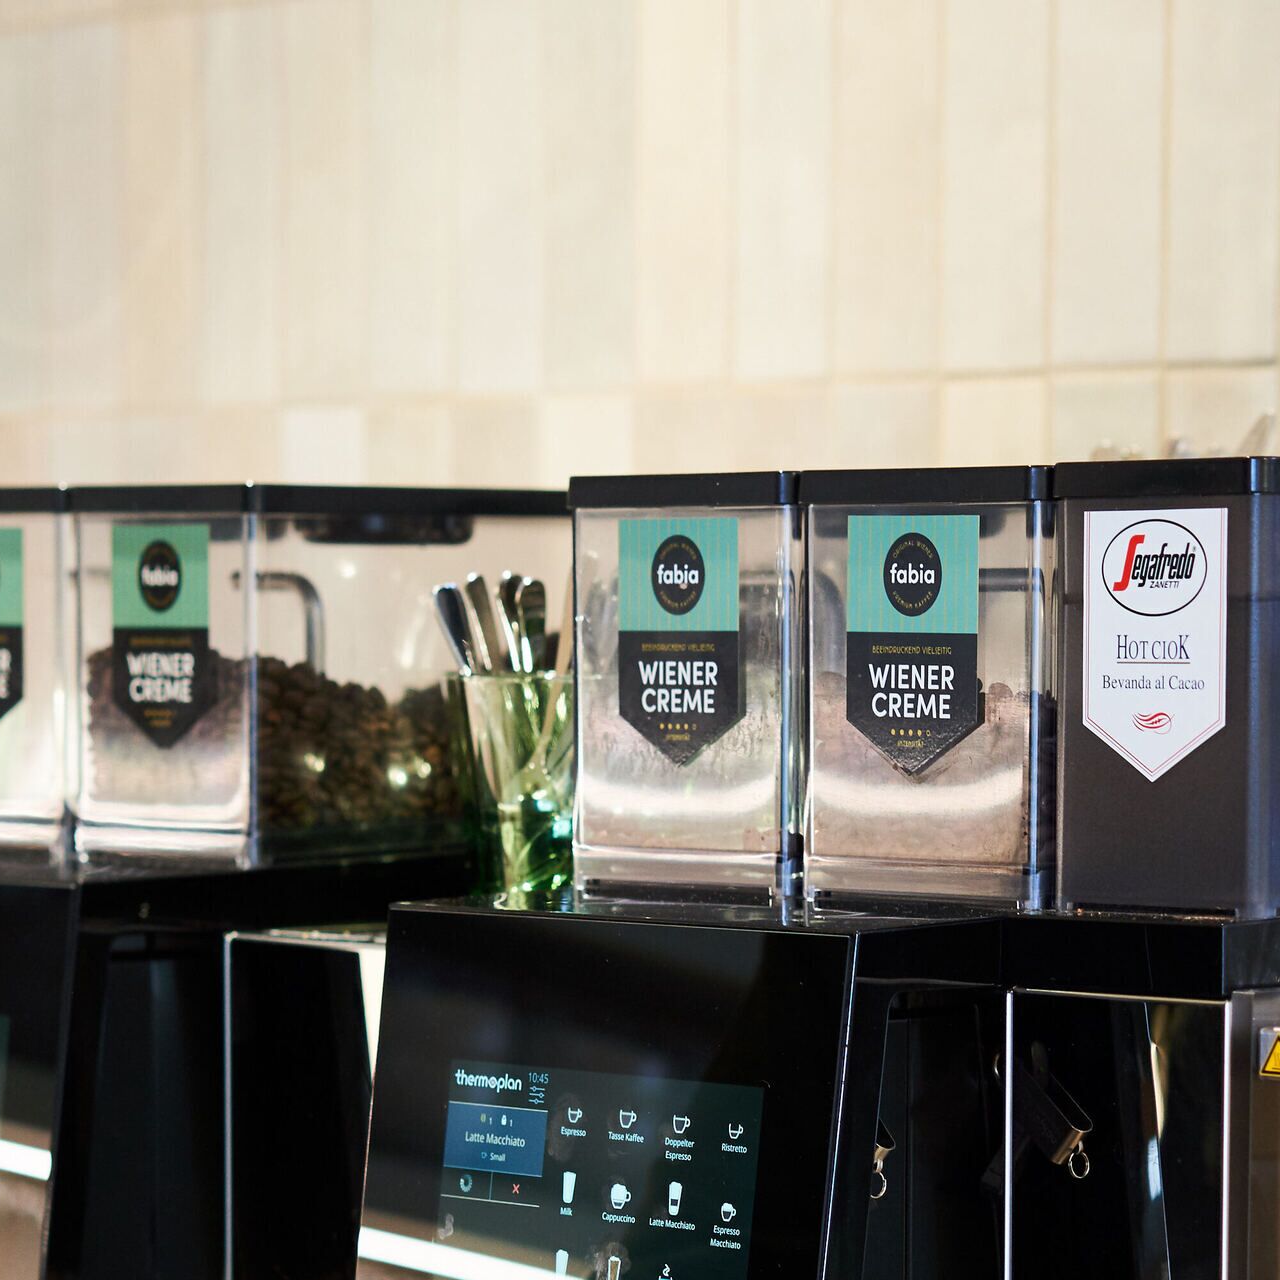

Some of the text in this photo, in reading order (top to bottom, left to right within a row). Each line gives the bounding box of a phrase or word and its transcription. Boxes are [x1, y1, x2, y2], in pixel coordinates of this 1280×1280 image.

[1112, 534, 1196, 592] Segafredo
[657, 563, 699, 584] fabia
[890, 562, 935, 584] fabia
[1149, 580, 1180, 589] ZANETTI
[126, 652, 194, 677] WIENER
[638, 660, 718, 686] WIENER
[868, 663, 955, 690] WIENER
[129, 677, 192, 702] CREME
[1102, 675, 1205, 690] Bevanda al Cacao
[641, 688, 715, 713] CREME
[871, 692, 951, 719] CREME
[455, 1068, 549, 1093] thermoplan 10:45
[560, 1126, 586, 1137] Espresso
[608, 1131, 644, 1143] Tasse Kaffee
[465, 1131, 526, 1147] Latte Macchiato
[664, 1137, 695, 1149] Doppelter
[721, 1142, 747, 1154] Ristretto
[490, 1152, 506, 1162] Small
[665, 1150, 692, 1162] Espresso
[560, 1206, 572, 1216] Milk
[601, 1212, 636, 1224] Cappuccino
[649, 1217, 696, 1231] Latte Macchiato
[713, 1225, 740, 1237] Espresso
[710, 1238, 741, 1250] Macchiato
